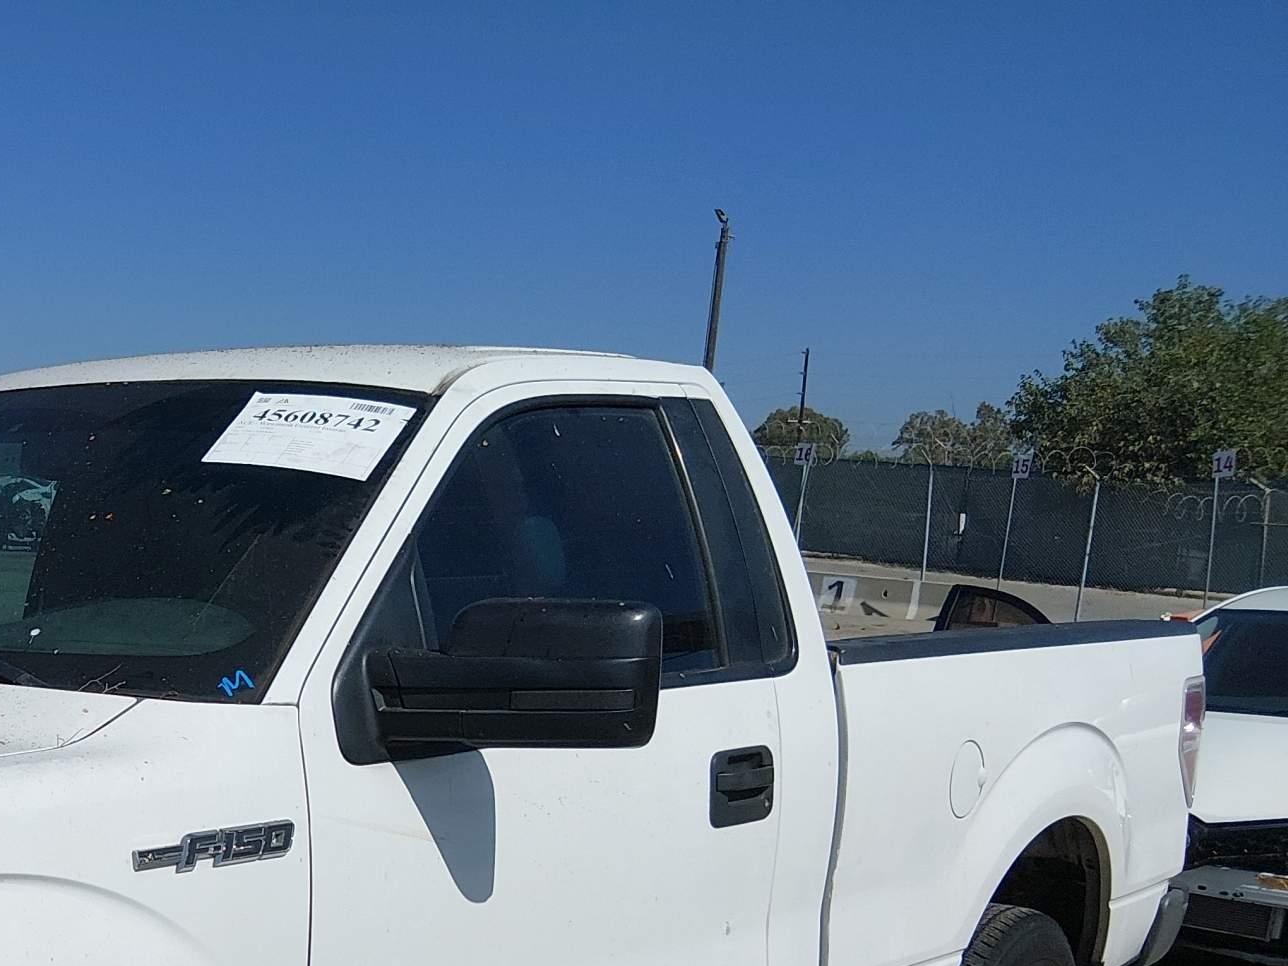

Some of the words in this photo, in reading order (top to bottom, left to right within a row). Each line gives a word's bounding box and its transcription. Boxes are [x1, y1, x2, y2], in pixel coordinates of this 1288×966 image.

[252, 408, 381, 432] 45608742
[1013, 458, 1029, 474] 15
[1214, 455, 1233, 473] 14
[176, 819, 295, 873] F-150
